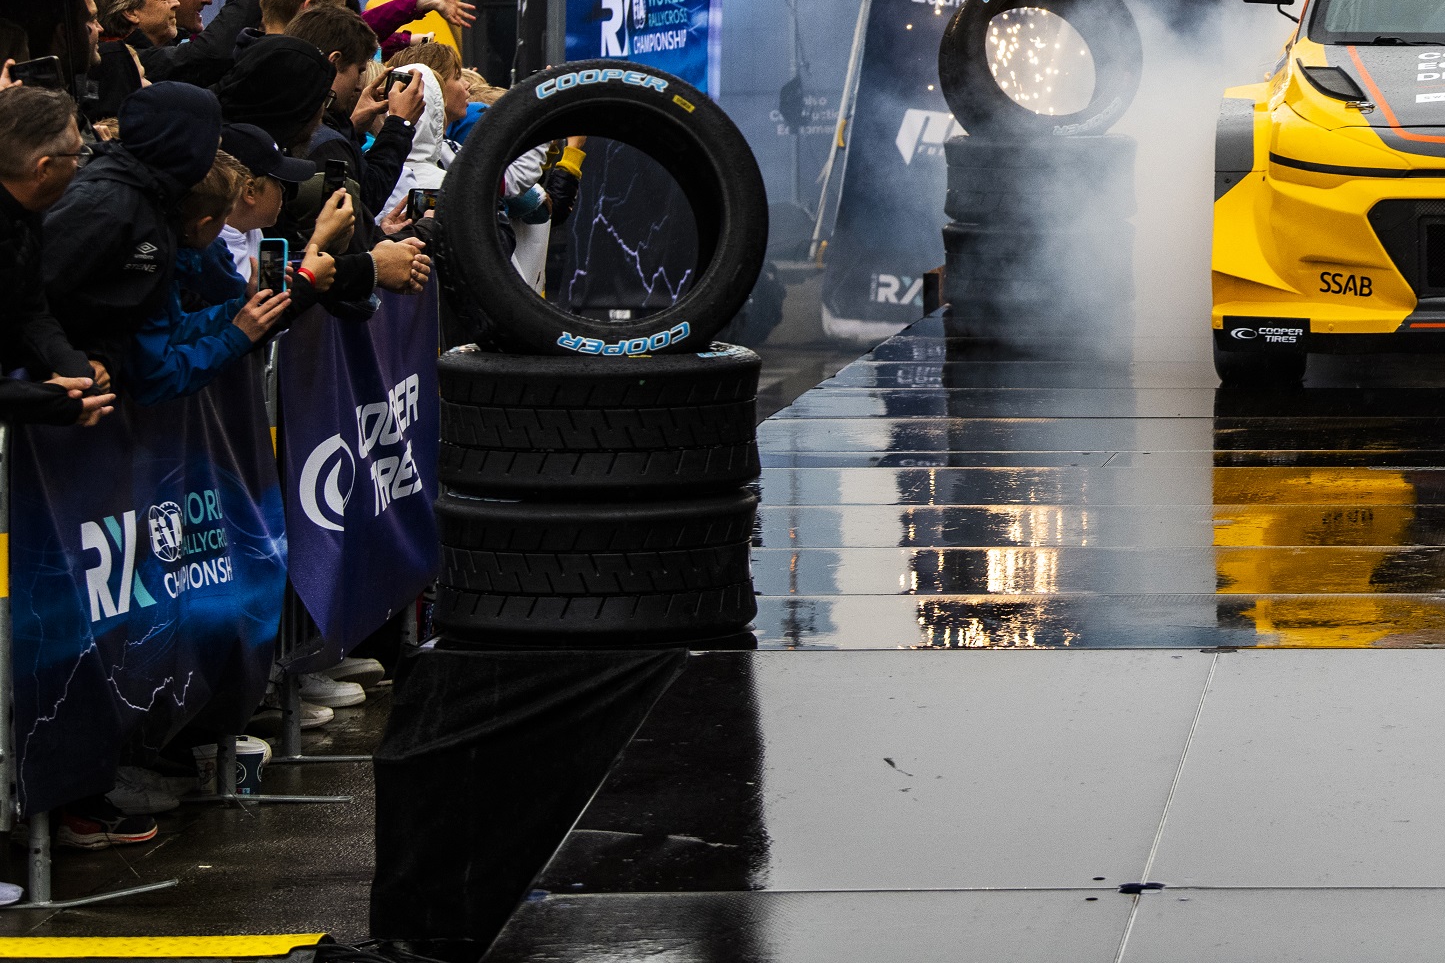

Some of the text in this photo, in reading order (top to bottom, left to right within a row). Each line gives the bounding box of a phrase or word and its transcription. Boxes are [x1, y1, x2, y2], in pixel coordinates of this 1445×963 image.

[535, 68, 669, 99] COOPER
[1319, 271, 1373, 297] SSAB
[556, 321, 690, 355] COOPER
[1258, 327, 1303, 336] COOPER
[1265, 335, 1297, 343] TIRES
[80, 509, 157, 622] RX
